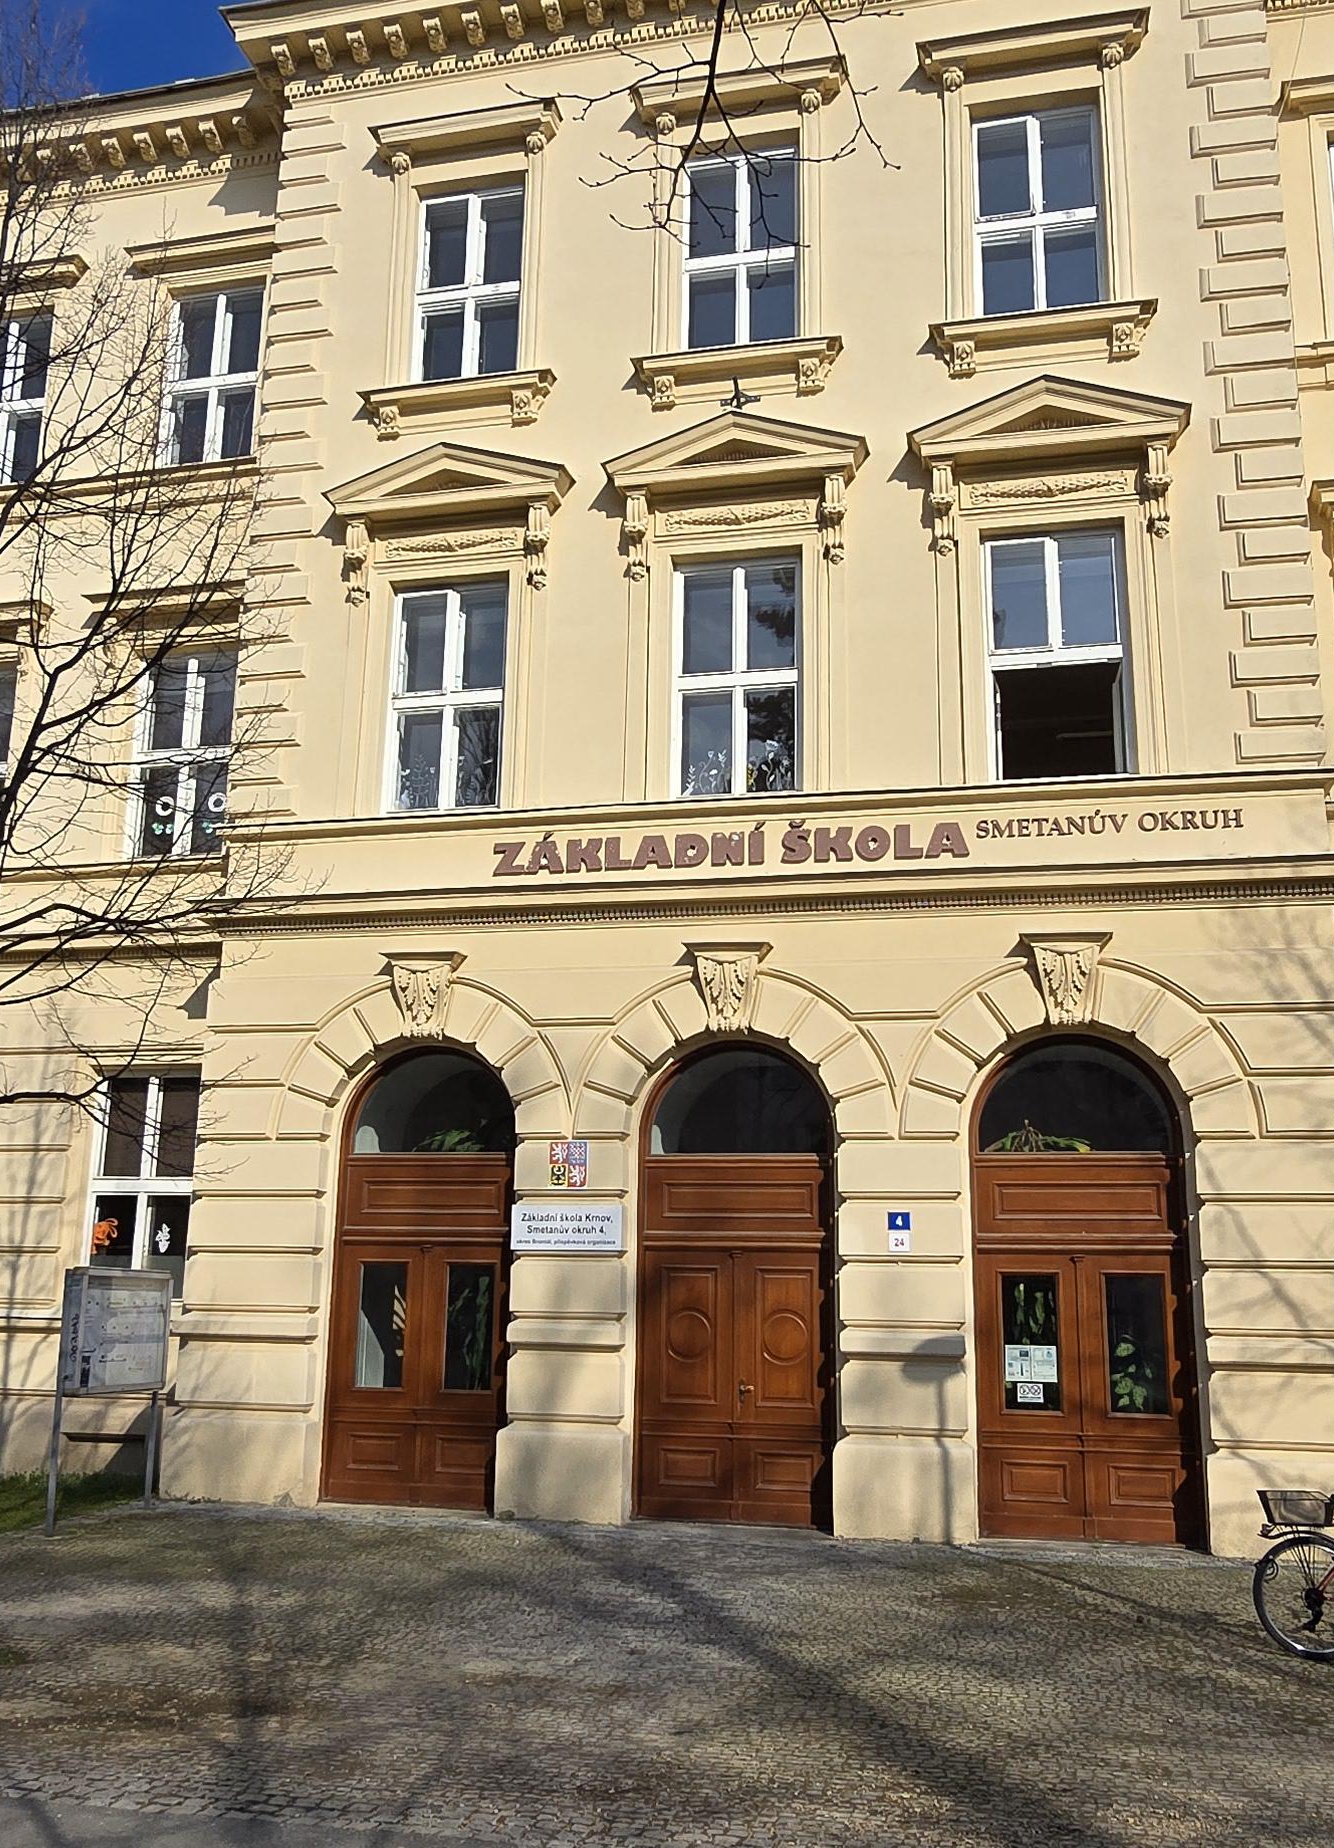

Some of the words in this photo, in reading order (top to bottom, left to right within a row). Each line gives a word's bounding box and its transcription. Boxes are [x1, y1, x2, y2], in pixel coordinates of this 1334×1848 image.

[492, 821, 766, 877] ZÁKLADNÍ
[780, 818, 970, 864] ŠKOLA
[975, 809, 1128, 839] SMETANŮV
[1137, 808, 1244, 832] OKRUH
[521, 1213, 557, 1222] Základní
[559, 1212, 583, 1222] škola
[585, 1213, 613, 1224] Krnov,
[895, 1215, 903, 1226] 4
[526, 1224, 570, 1234] Smetanův
[571, 1225, 597, 1234] okruh
[894, 1237, 905, 1247] 24
